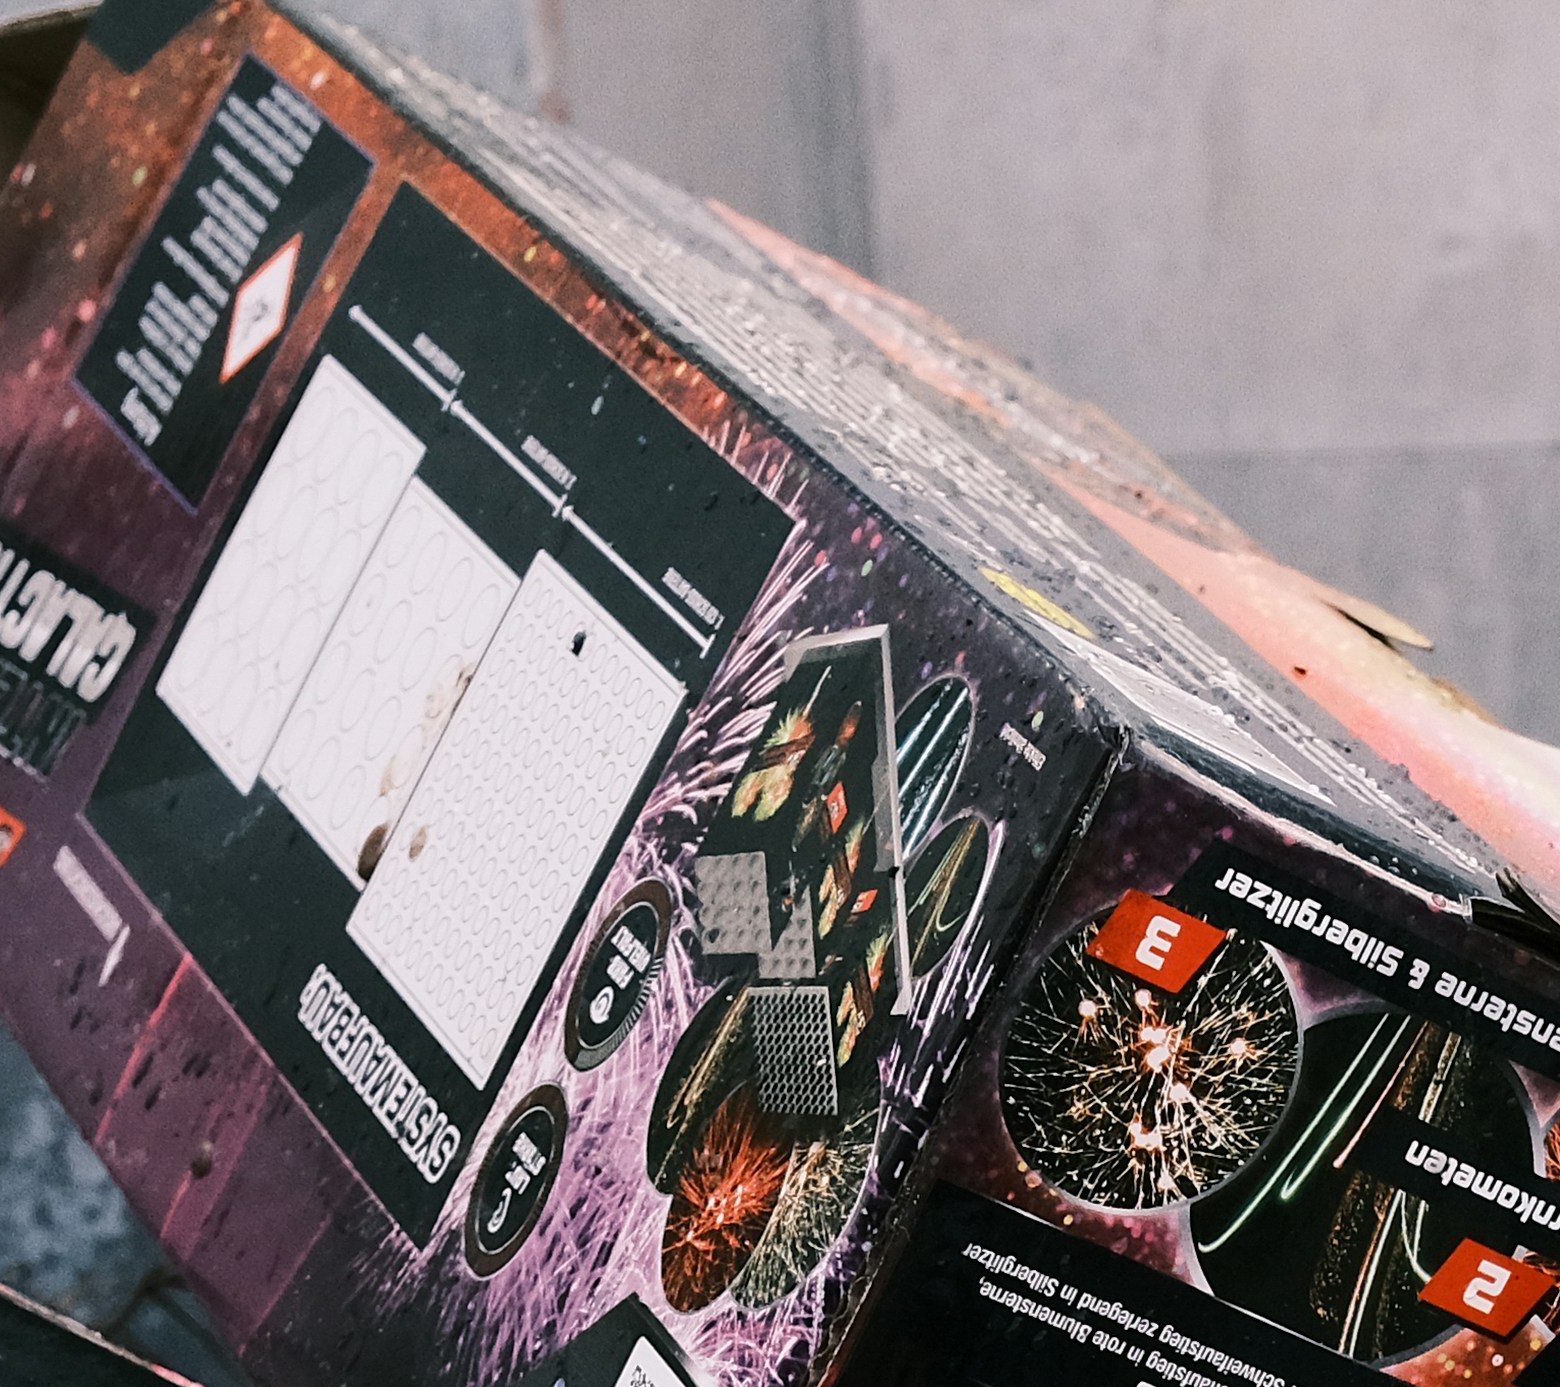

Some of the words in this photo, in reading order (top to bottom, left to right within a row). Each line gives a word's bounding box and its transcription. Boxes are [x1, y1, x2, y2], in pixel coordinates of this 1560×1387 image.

[1135, 915, 1180, 969] 3
[1215, 869, 1402, 975] Silberglitzer
[1408, 958, 1429, 989] &
[963, 1244, 1058, 1296] Silberglitzer
[1059, 1284, 1077, 1306] in
[1463, 1259, 1510, 1313] 2
[1076, 1292, 1158, 1336] zerlegend
